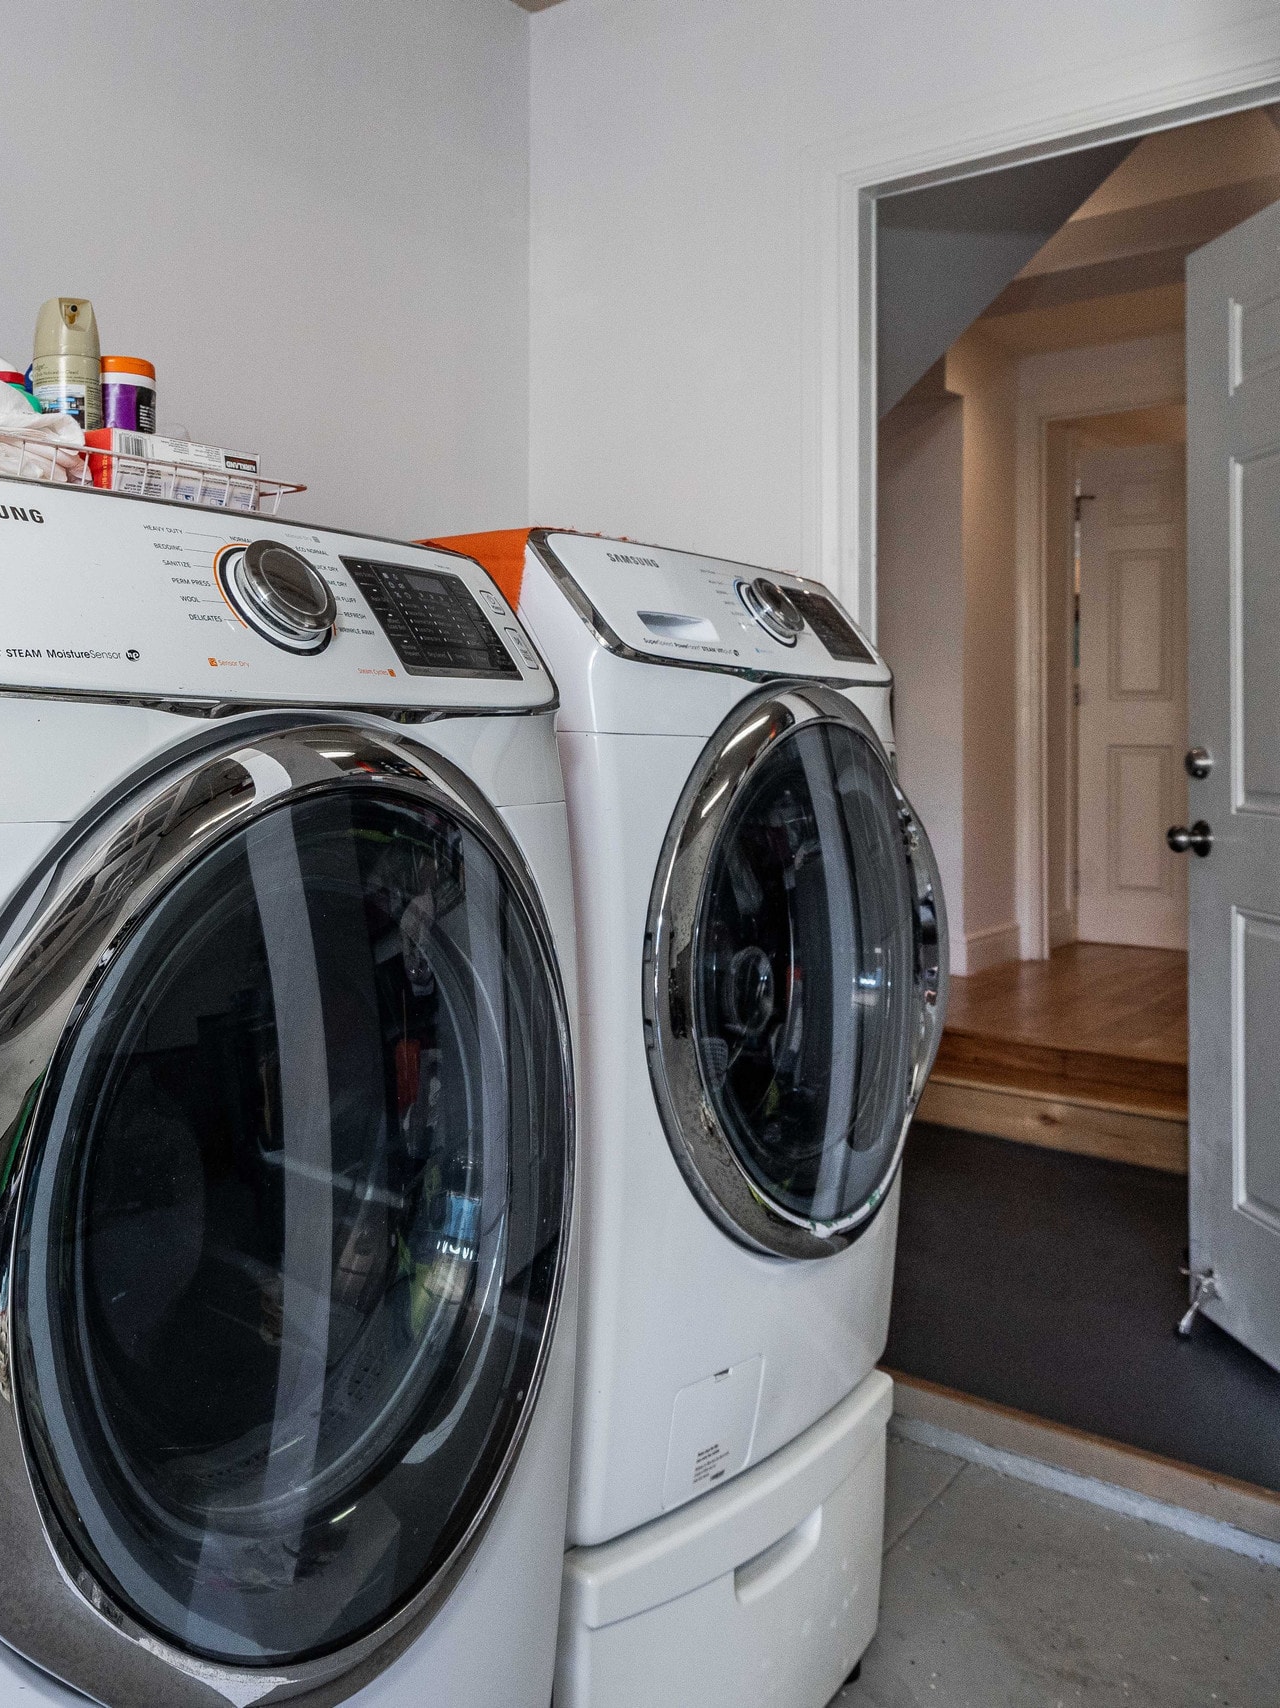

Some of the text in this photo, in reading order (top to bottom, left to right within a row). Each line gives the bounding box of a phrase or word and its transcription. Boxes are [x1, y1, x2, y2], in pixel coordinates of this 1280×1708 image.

[143, 524, 165, 532] HEAVY
[153, 542, 184, 552] BEDDING
[162, 559, 192, 569] SANITIZE
[606, 552, 660, 568] SAMSUNG
[171, 577, 211, 587] PERM PRESS
[180, 595, 201, 603] WOOL
[188, 613, 223, 623] DELICATES
[343, 611, 367, 620] REFRESH
[6, 648, 42, 659] STEAM
[47, 649, 121, 660] MoistureSensor
